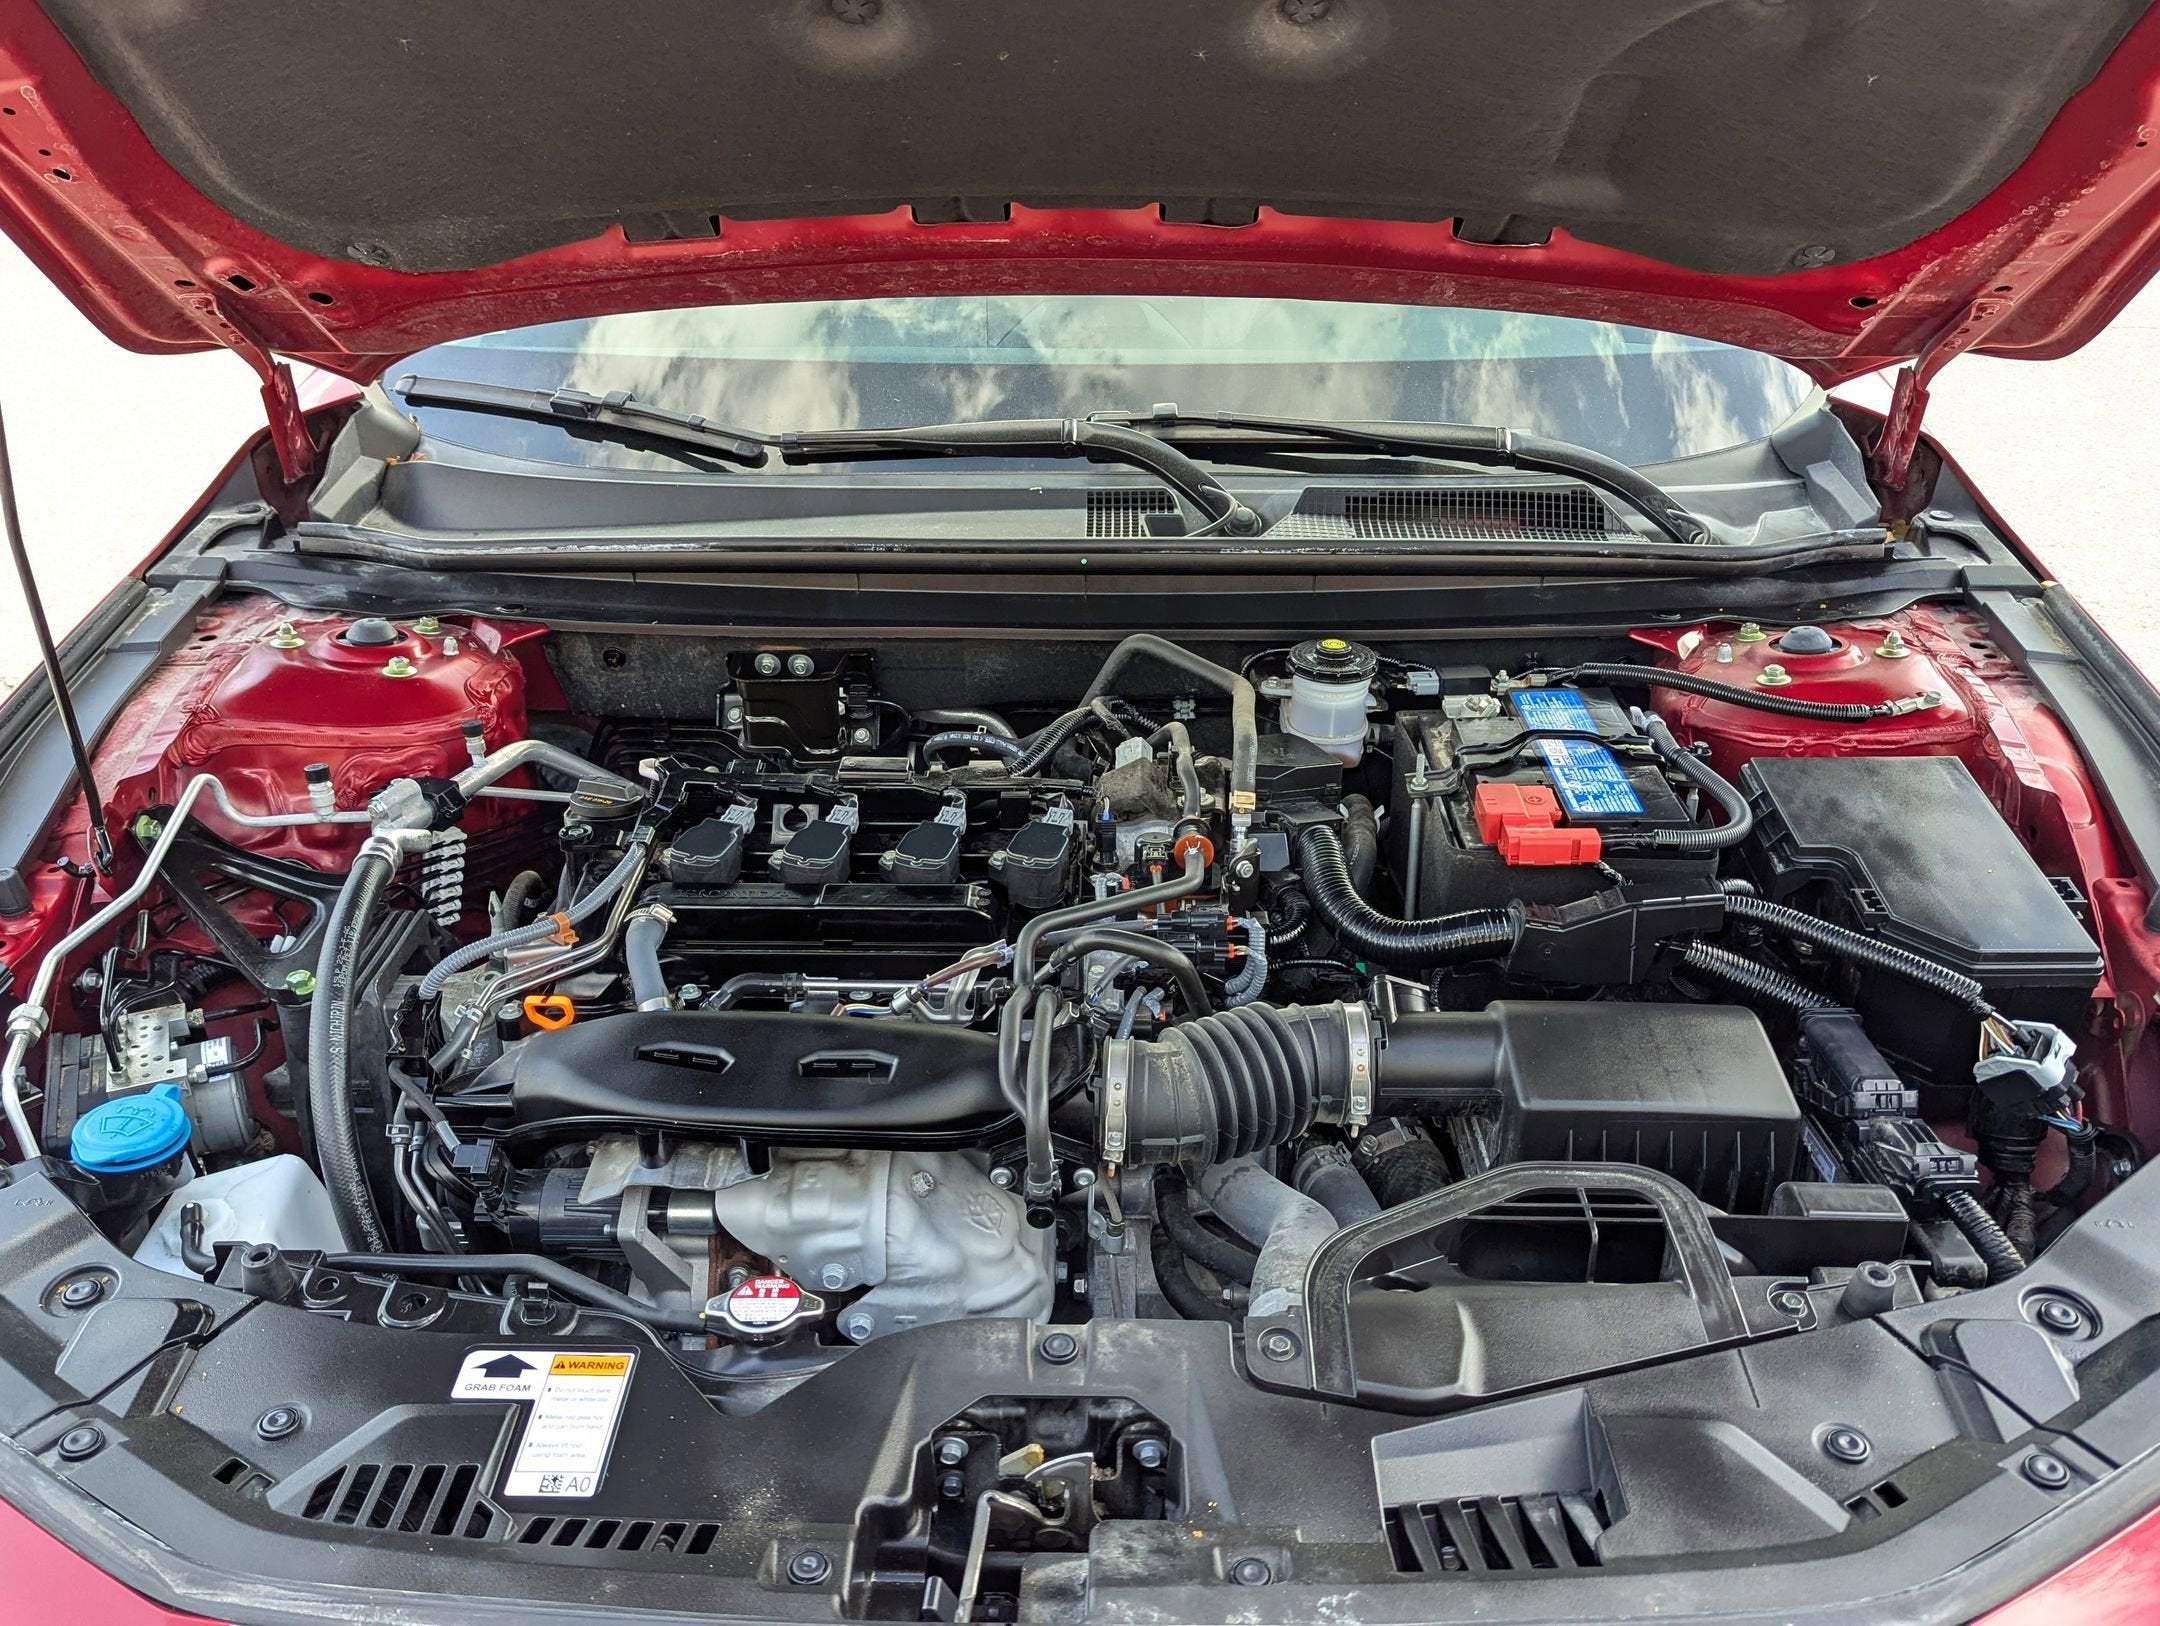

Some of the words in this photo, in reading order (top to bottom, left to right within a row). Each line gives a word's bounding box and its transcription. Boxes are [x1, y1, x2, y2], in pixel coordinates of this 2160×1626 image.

[329, 1000, 345, 1042] NICHIRIN
[568, 1361, 625, 1370] WARNING
[464, 1383, 496, 1391] GRAB
[499, 1384, 532, 1392] FOAM
[565, 1476, 591, 1492] A0
